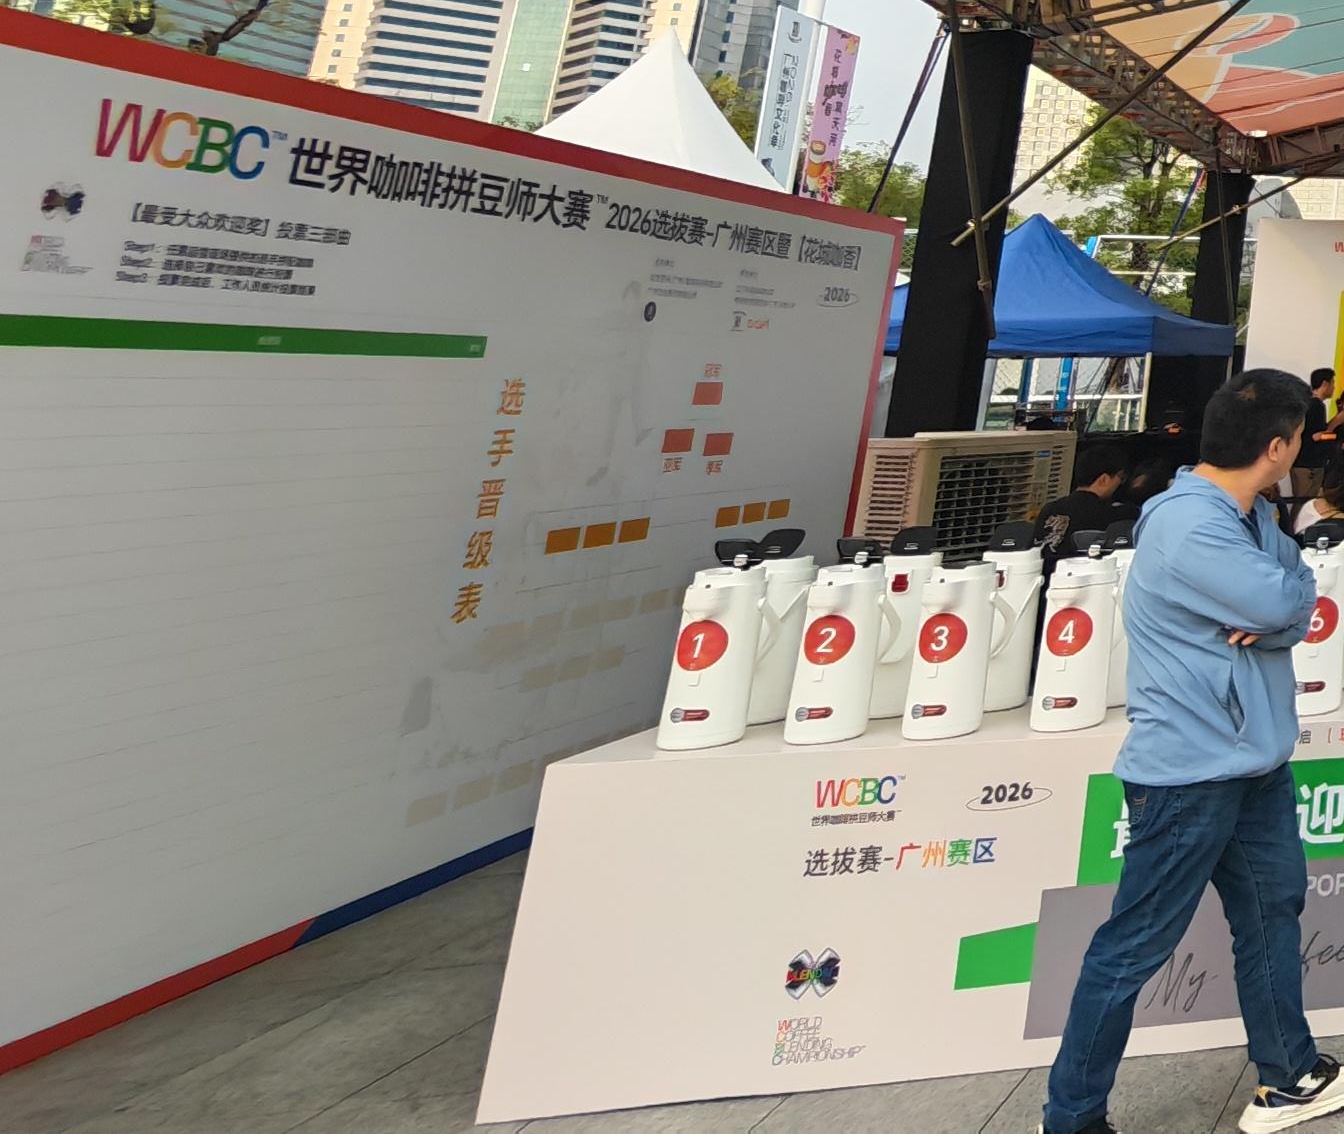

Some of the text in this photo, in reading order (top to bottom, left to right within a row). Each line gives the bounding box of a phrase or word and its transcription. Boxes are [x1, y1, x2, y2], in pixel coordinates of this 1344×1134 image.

[96, 98, 270, 180] WCBC
[288, 137, 595, 231] 世界咖啡拼豆师大赛
[450, 378, 526, 624] 选手晋级表
[1057, 620, 1076, 644] 4
[1307, 608, 1326, 633] 6
[691, 633, 705, 659] 1
[816, 628, 838, 654] 2
[929, 625, 949, 651] 3
[816, 776, 898, 808] WCBC
[980, 782, 1034, 805] 2026
